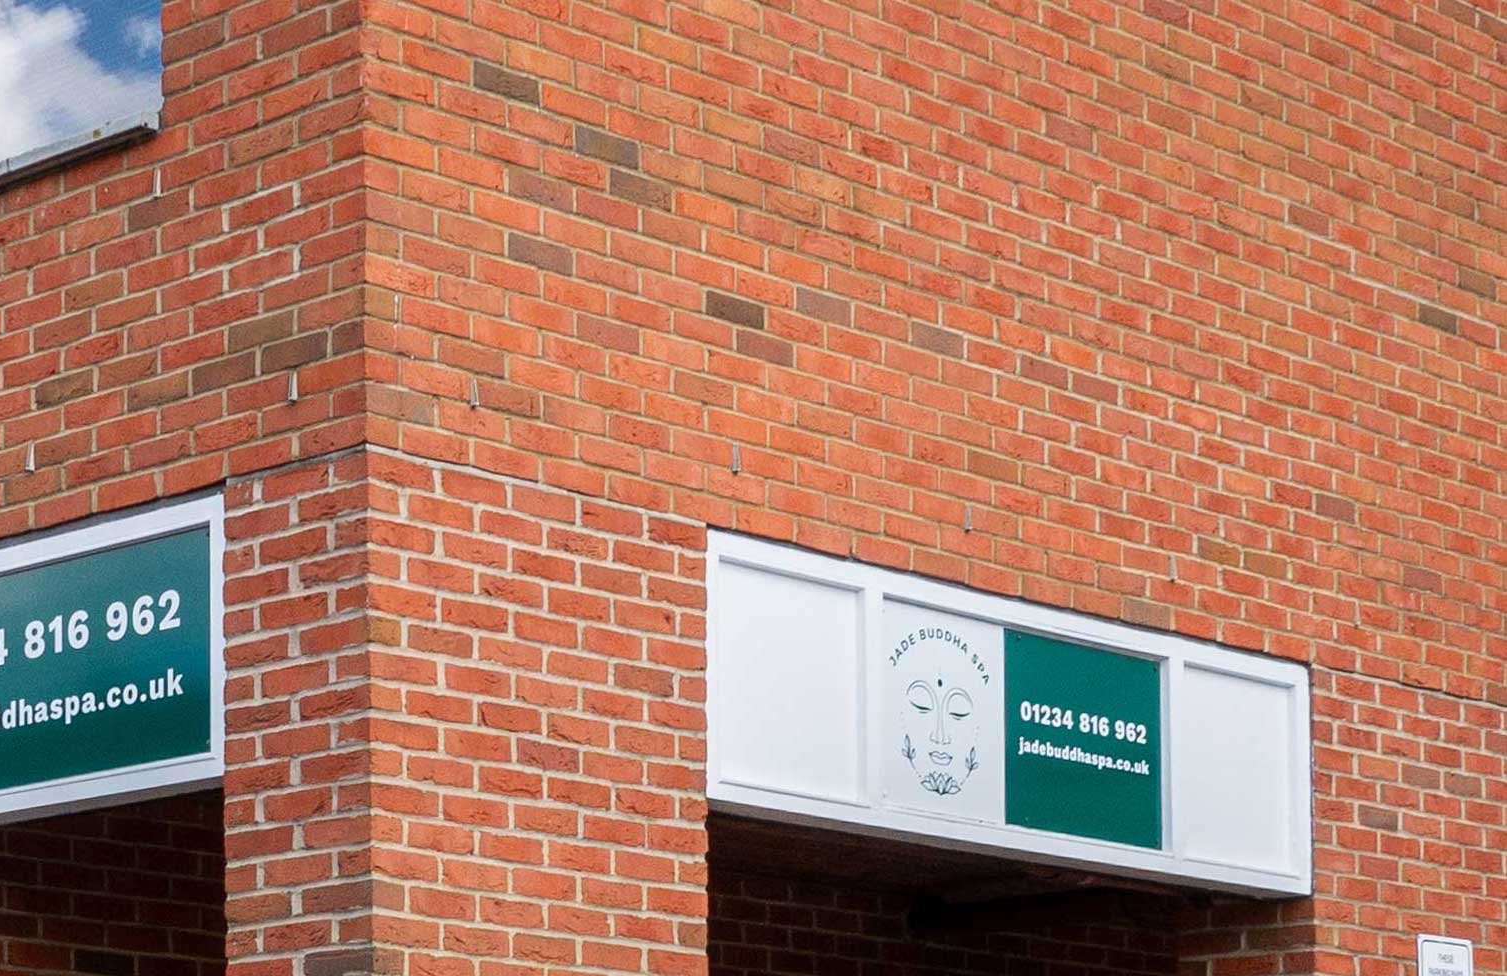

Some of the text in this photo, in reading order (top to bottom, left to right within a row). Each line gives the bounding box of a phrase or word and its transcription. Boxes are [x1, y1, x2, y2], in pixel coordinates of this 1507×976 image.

[24, 609, 89, 659] 816
[106, 589, 181, 641] 962
[889, 628, 990, 685] JADE BUDDHA SPA
[1020, 700, 1147, 744] 01234 816 962
[1018, 736, 1150, 775] jadebuddhaspa.co.uk
